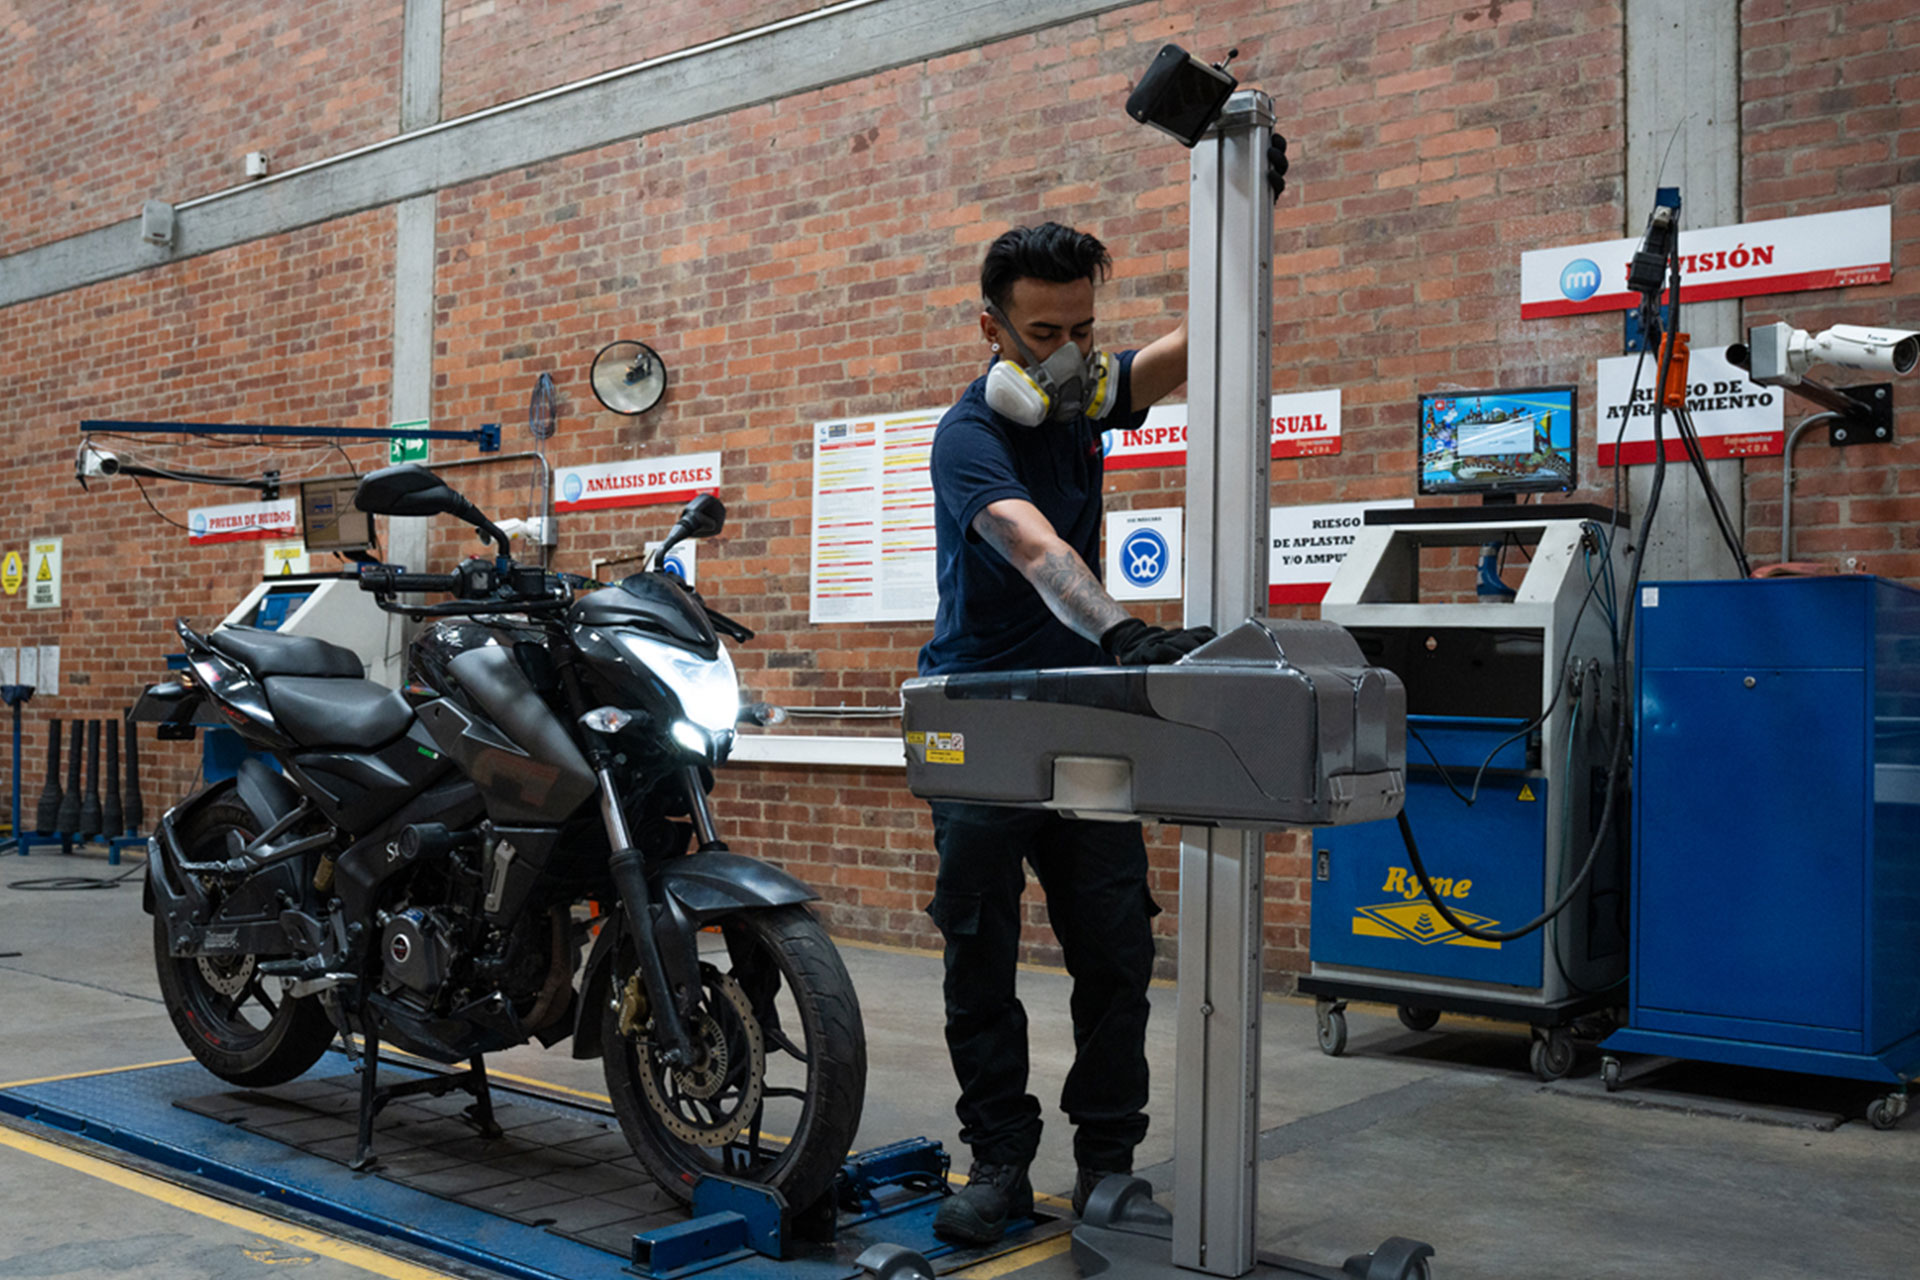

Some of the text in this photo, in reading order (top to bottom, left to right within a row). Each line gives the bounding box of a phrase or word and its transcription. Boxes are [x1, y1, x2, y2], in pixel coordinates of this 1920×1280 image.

[1714, 380, 1743, 394] DE
[1270, 413, 1328, 435] ISUAL
[586, 474, 645, 492] ANÁLISIS
[648, 472, 666, 488] DE
[669, 467, 713, 484] GASES
[209, 515, 244, 529] PRUEBA
[244, 513, 256, 527] DE
[1312, 517, 1361, 529] RIESGO
[1273, 538, 1290, 548] DE
[1382, 866, 1473, 899] Ryme
